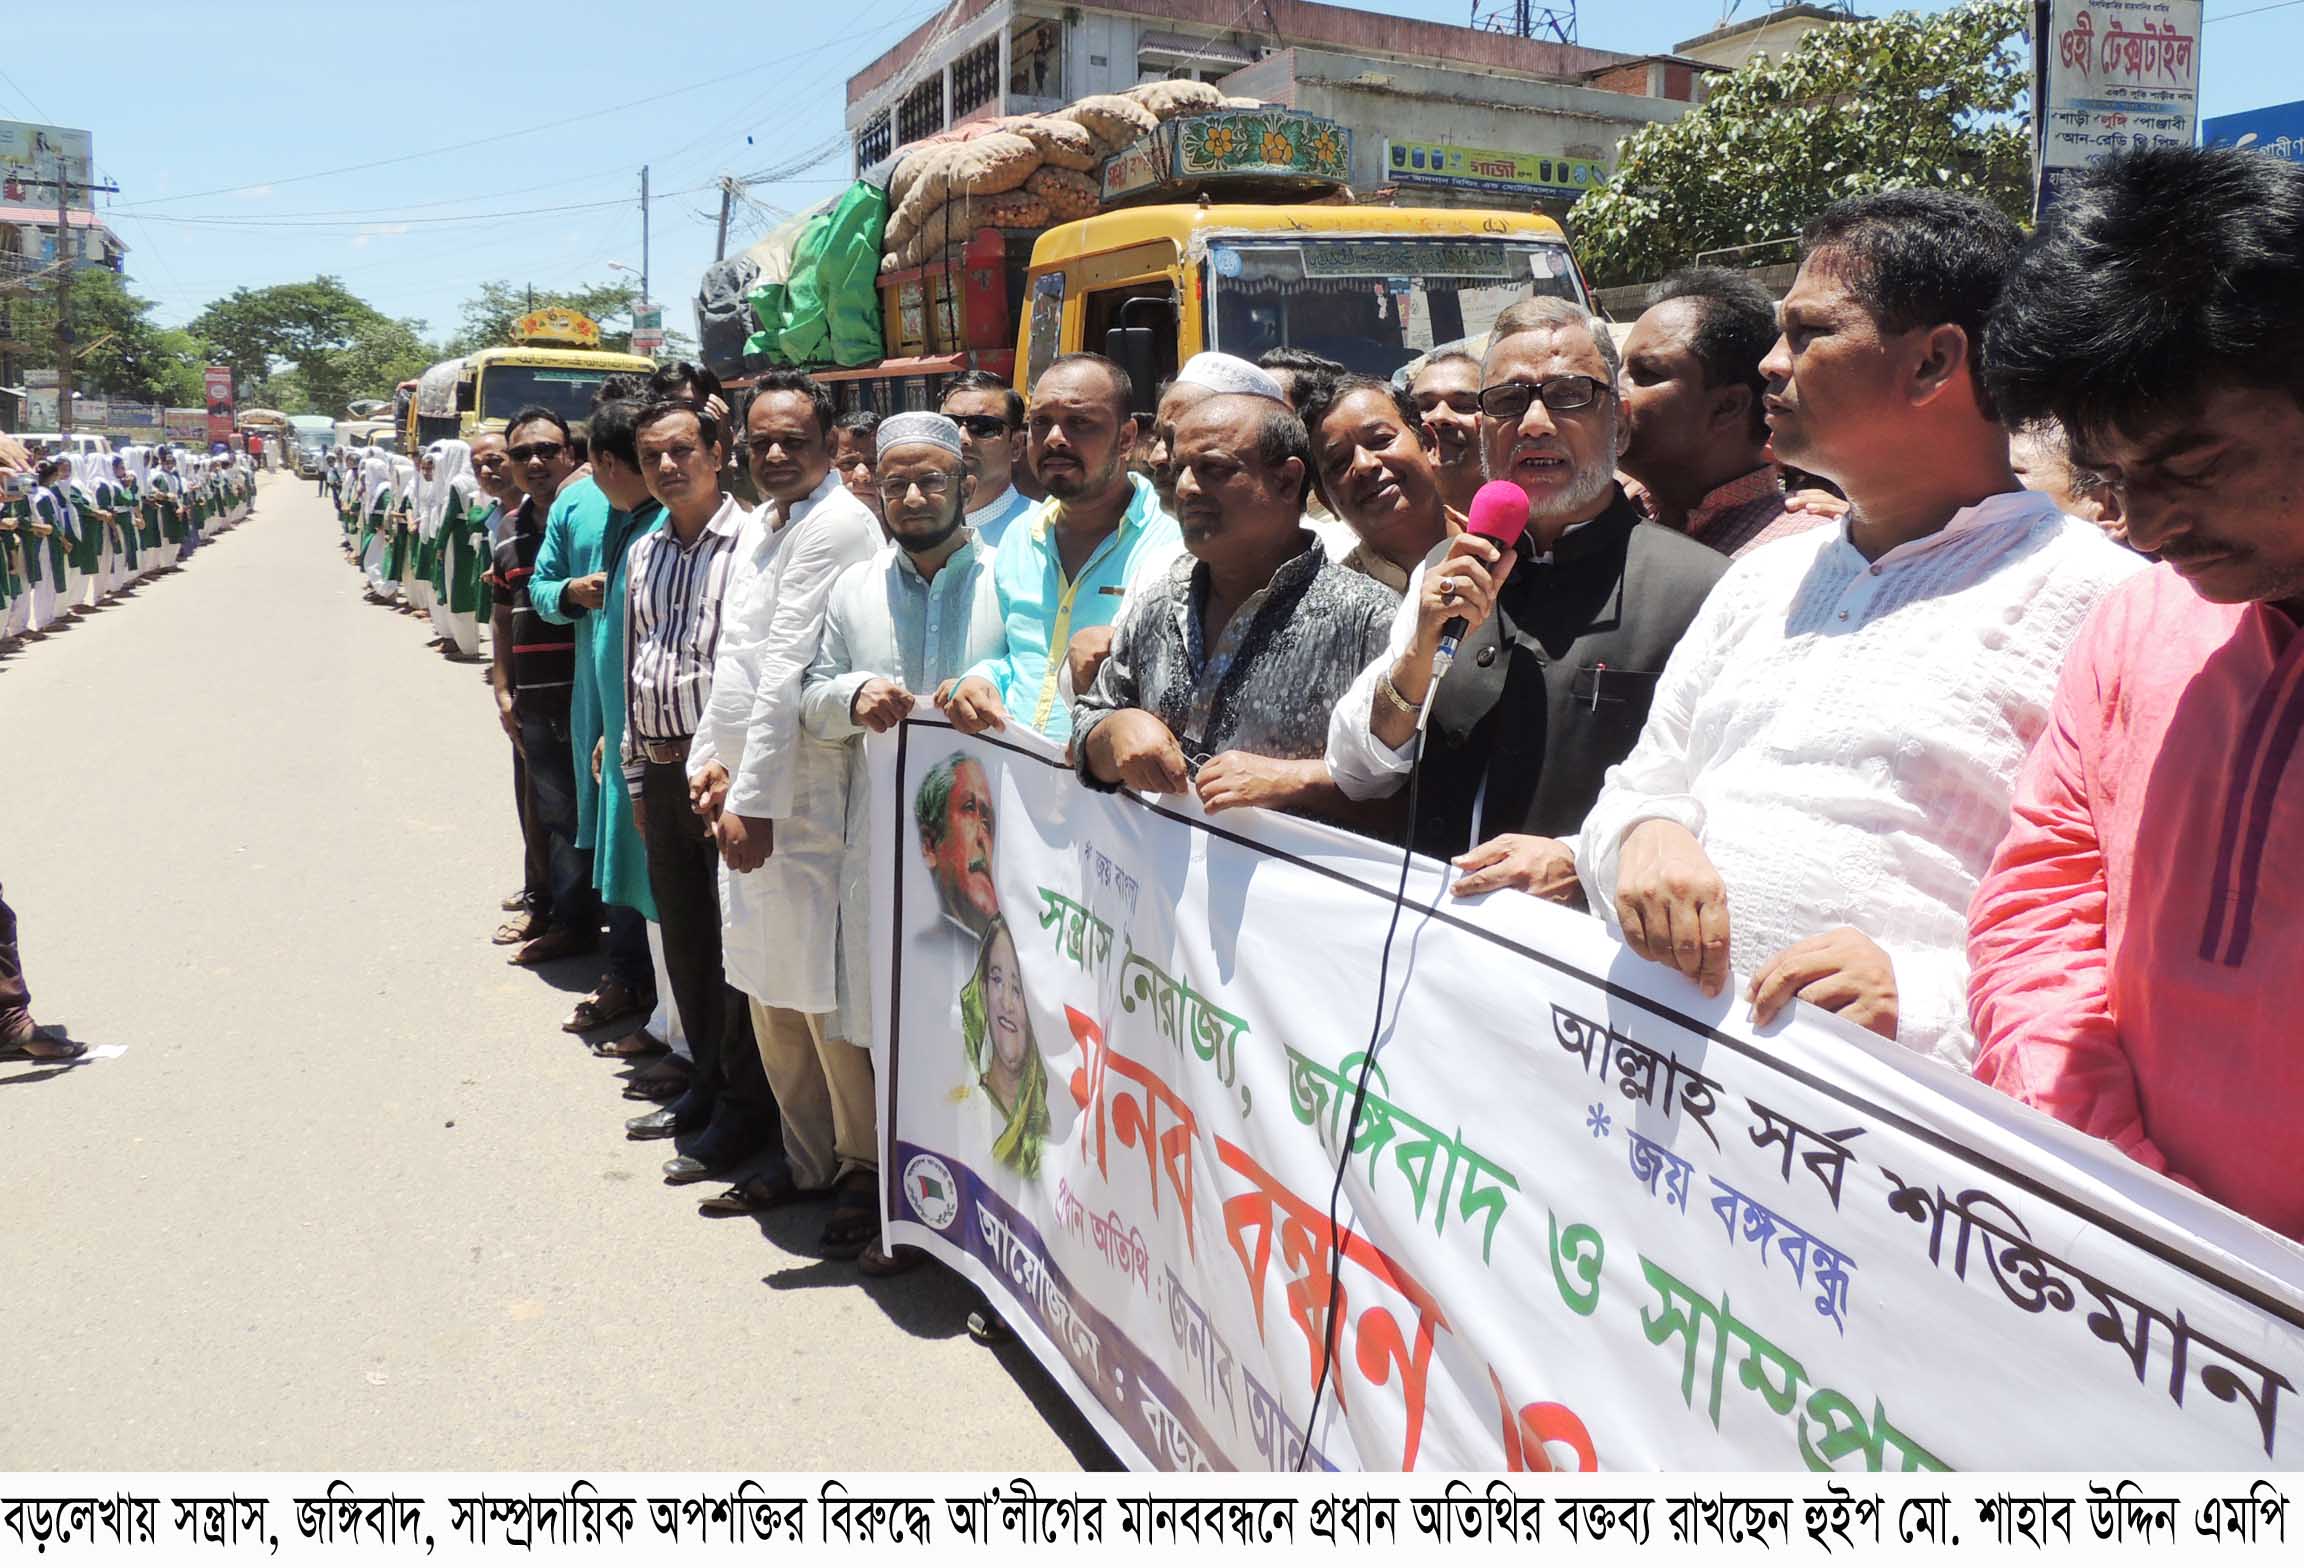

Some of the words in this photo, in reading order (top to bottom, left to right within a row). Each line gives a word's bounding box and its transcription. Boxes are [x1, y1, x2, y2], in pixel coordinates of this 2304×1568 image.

[2059, 11, 2094, 79] ওহী
[2101, 16, 2194, 82] টেক্সটাইল
[2100, 112, 2128, 129] লুঙ্গি
[2138, 115, 2187, 131] পাঞ্জাবী
[1037, 886, 1115, 981] সন্ত্রাস
[1283, 1042, 1520, 1268] জঙ্গিবাদ
[1548, 1207, 1605, 1317] ও
[976, 1198, 1101, 1382] আয়োজনে
[1063, 1003, 1200, 1265] মানব
[1213, 1133, 1453, 1471] বন্ধন
[1089, 1209, 1150, 1296] অতিথি
[1165, 1263, 1238, 1439] জনাব
[1550, 1002, 1724, 1152] আল্লাহ
[1745, 1097, 1867, 1211] সর্ব
[1878, 1165, 2299, 1460] শক্তিমান
[1628, 1128, 1695, 1216] জয়
[1709, 1175, 1858, 1336] বঙ্গবন্ধু
